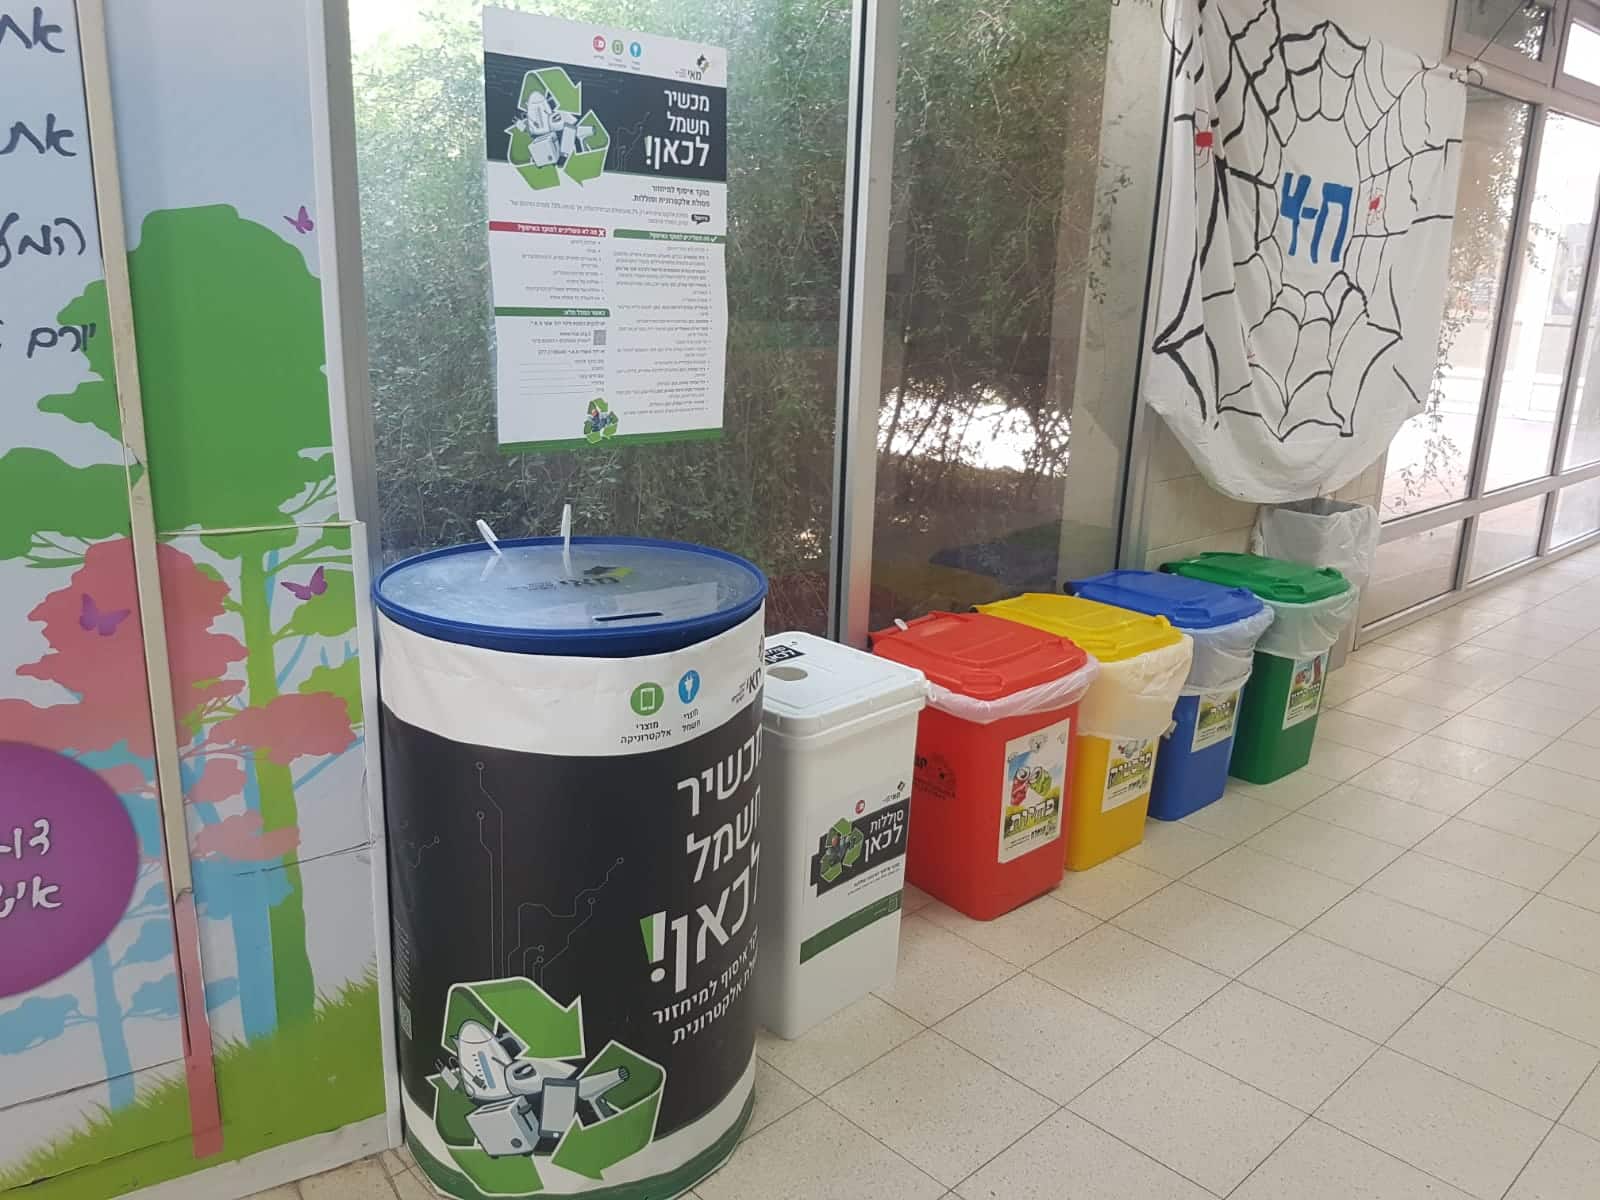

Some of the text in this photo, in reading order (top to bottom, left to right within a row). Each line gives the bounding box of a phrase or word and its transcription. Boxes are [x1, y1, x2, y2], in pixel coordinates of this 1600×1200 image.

[663, 89, 710, 112] מכשיר
[666, 112, 710, 137] חשמל
[645, 135, 710, 170] לכאן!
[620, 730, 672, 745] אלקטרוניקה
[635, 719, 659, 731] מוצרי
[869, 808, 904, 833] סוללות
[864, 823, 904, 862] לכאן
[720, 945, 749, 989] איסוף
[652, 979, 718, 1025] למיחזור
[671, 981, 743, 1045] אלקטרונית
